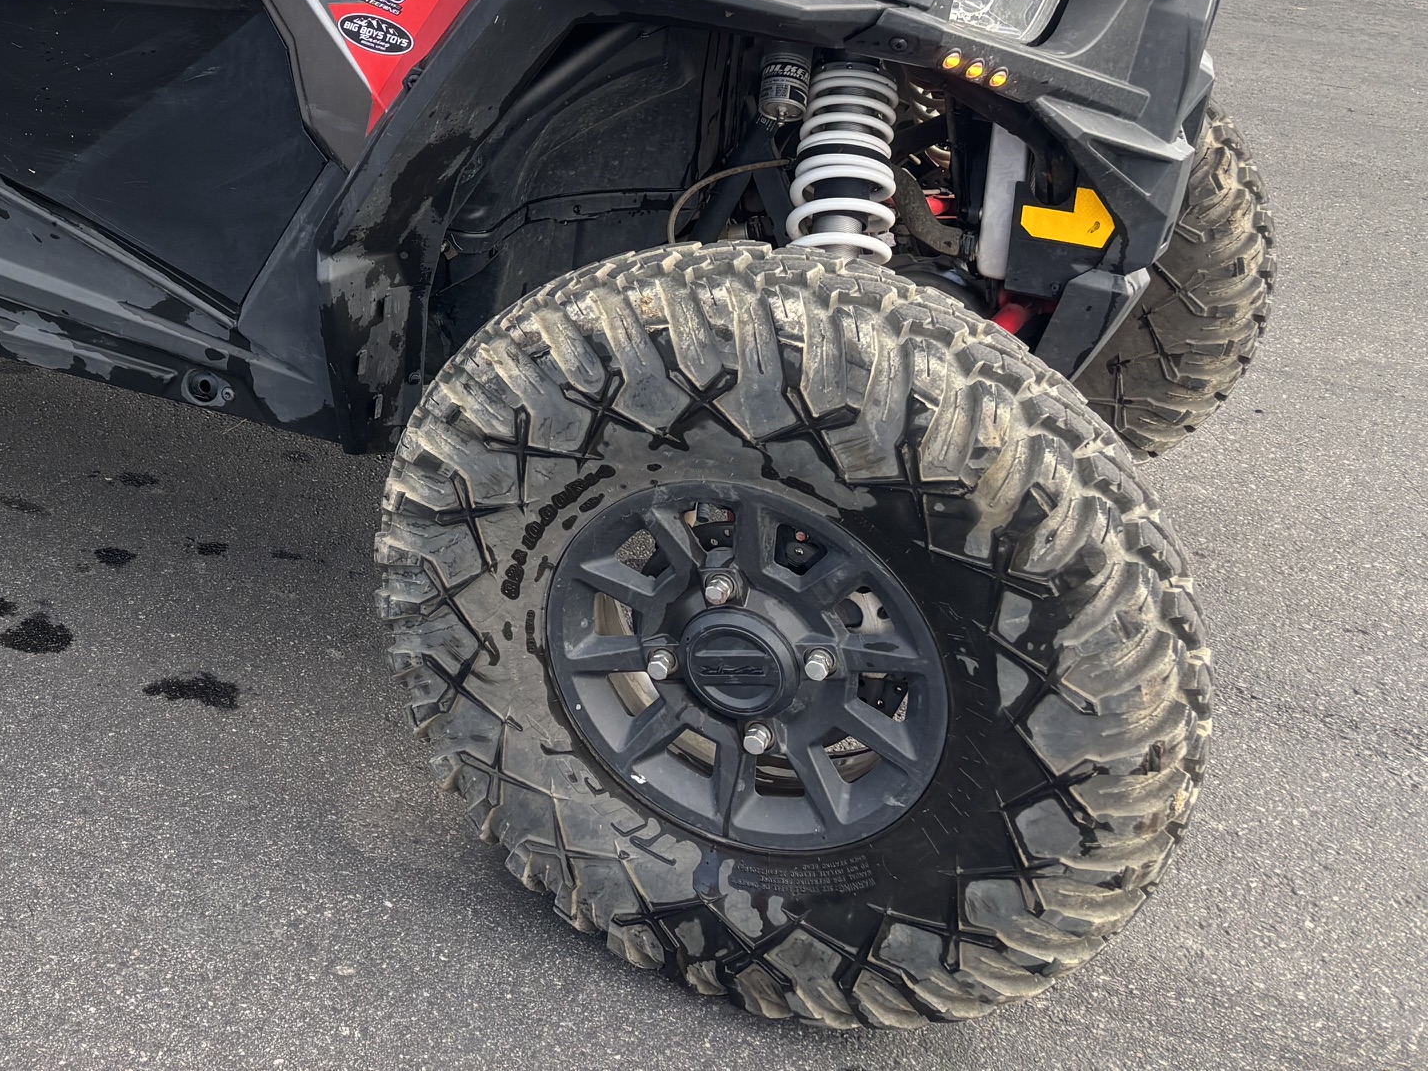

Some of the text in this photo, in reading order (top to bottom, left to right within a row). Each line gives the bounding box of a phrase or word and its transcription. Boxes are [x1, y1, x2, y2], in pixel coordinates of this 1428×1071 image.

[343, 20, 360, 33] BIG
[360, 27, 385, 40] BOYS
[385, 33, 409, 48] TOYS
[359, 33, 391, 48] Racing
